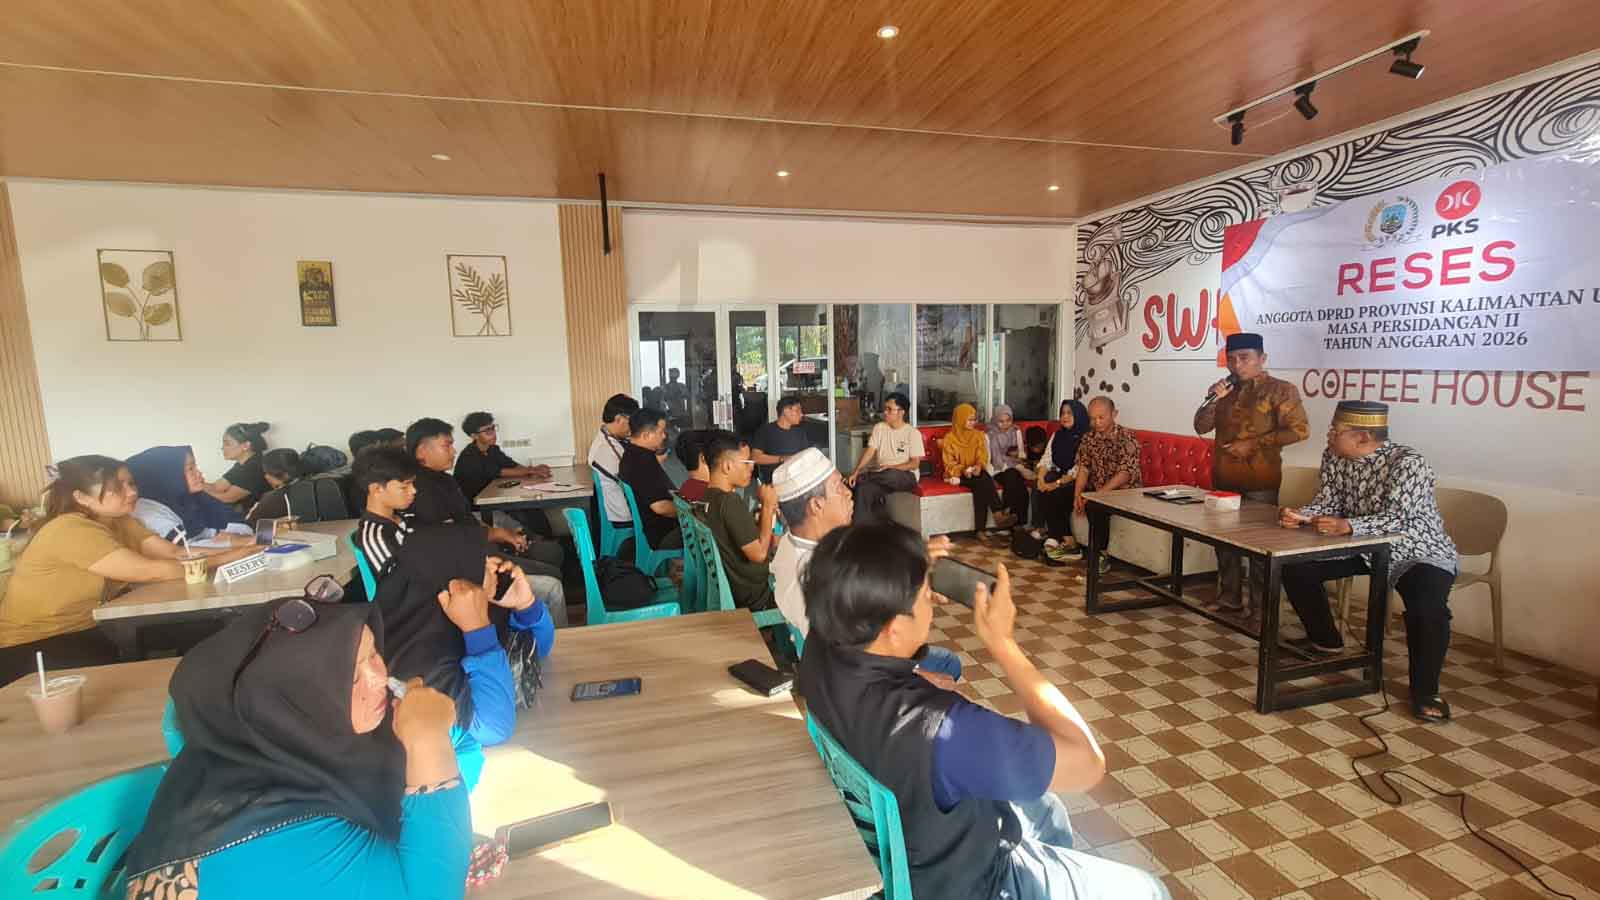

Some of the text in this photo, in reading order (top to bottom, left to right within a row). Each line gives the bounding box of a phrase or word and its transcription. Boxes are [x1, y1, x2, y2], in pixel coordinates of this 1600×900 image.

[1431, 218, 1479, 239] PKS
[1337, 240, 1516, 296] RESES
[1142, 287, 1221, 350] SW
[1256, 310, 1314, 325] ANGGOTA
[1317, 307, 1354, 321] DPRD
[1359, 301, 1435, 319] PROVINSI
[1440, 288, 1584, 313] KALIMANTAN
[1328, 312, 1520, 335] MASA PERSIDANGAN II
[1323, 331, 1528, 350] TAHUN ANGGARAN 2026
[1302, 368, 1591, 412] COFFEE HOUSE
